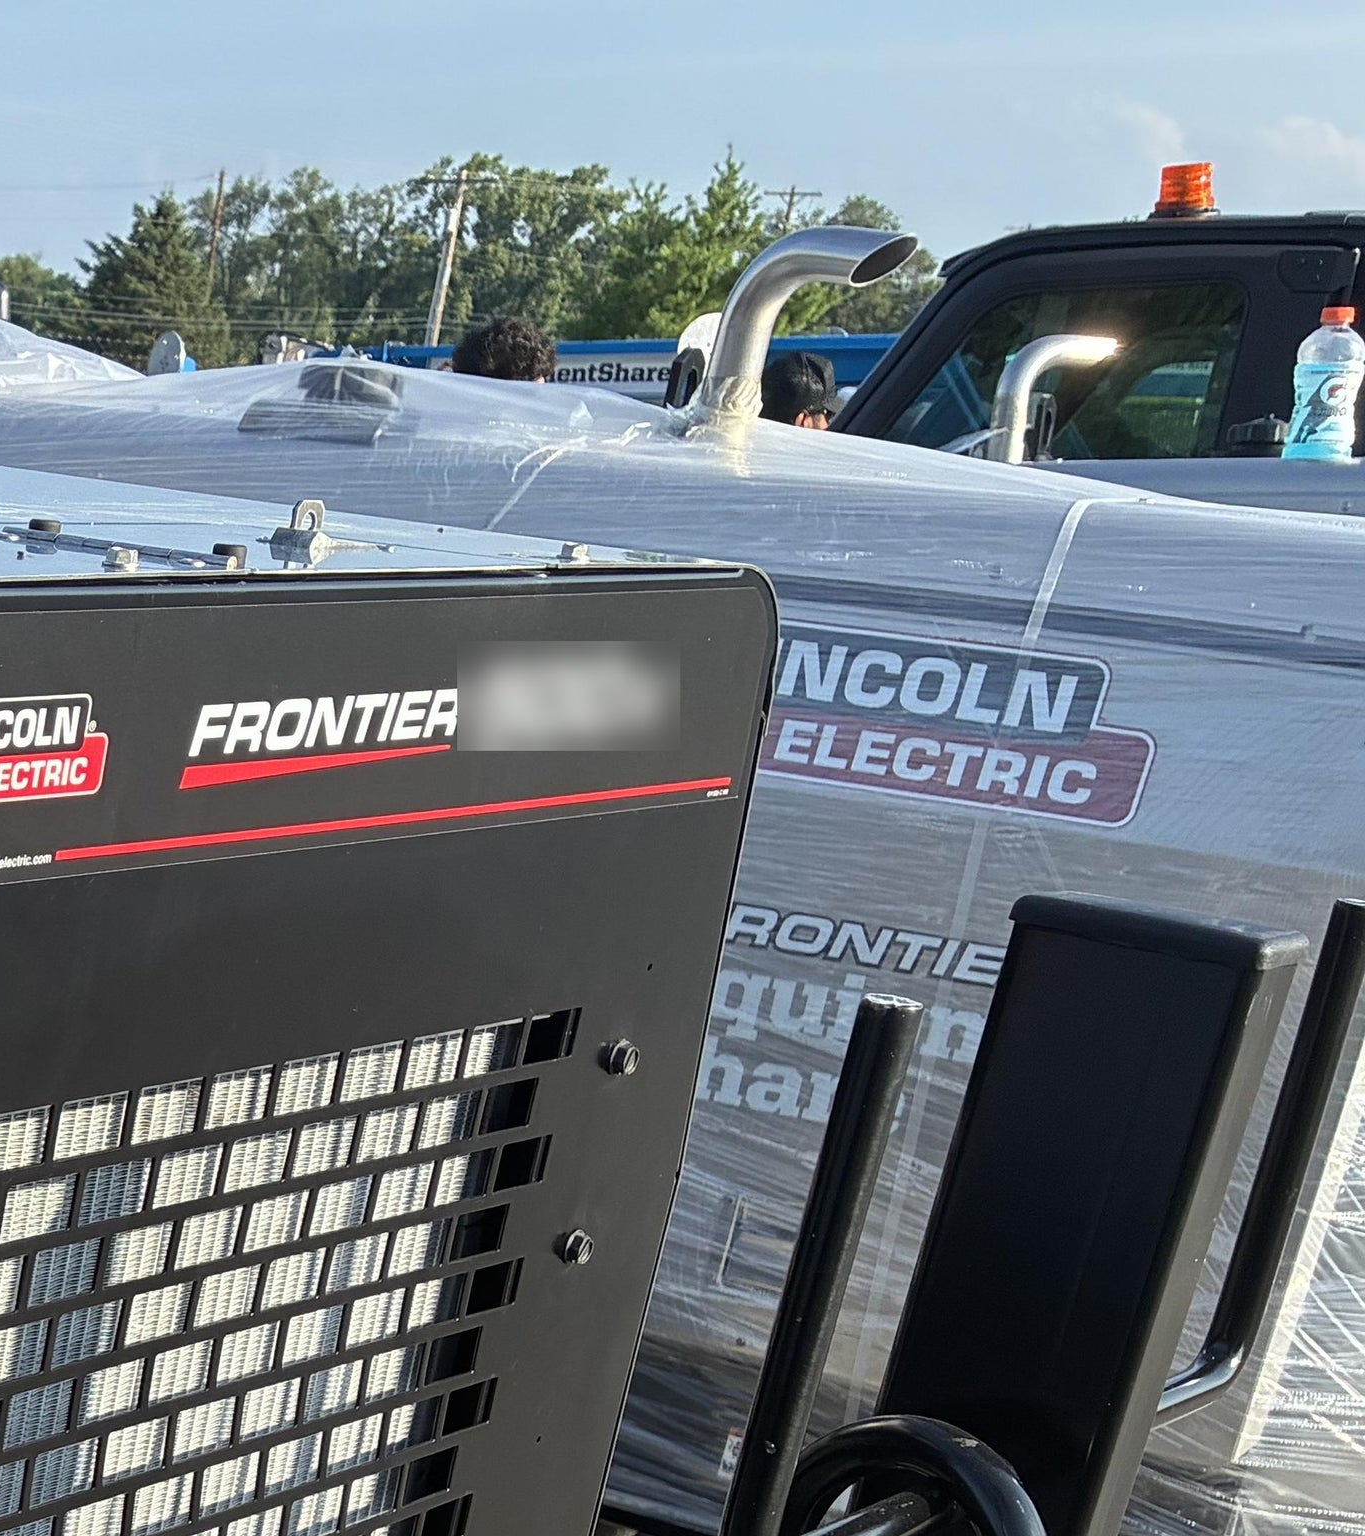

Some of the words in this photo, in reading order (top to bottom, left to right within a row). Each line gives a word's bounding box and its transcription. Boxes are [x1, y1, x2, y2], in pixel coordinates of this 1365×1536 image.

[547, 362, 670, 383] entShare
[188, 688, 457, 757] FRONTIER
[774, 638, 1079, 733] NCOLN
[773, 719, 1098, 805] ELECTRIC
[725, 903, 1007, 986] RONTIE
